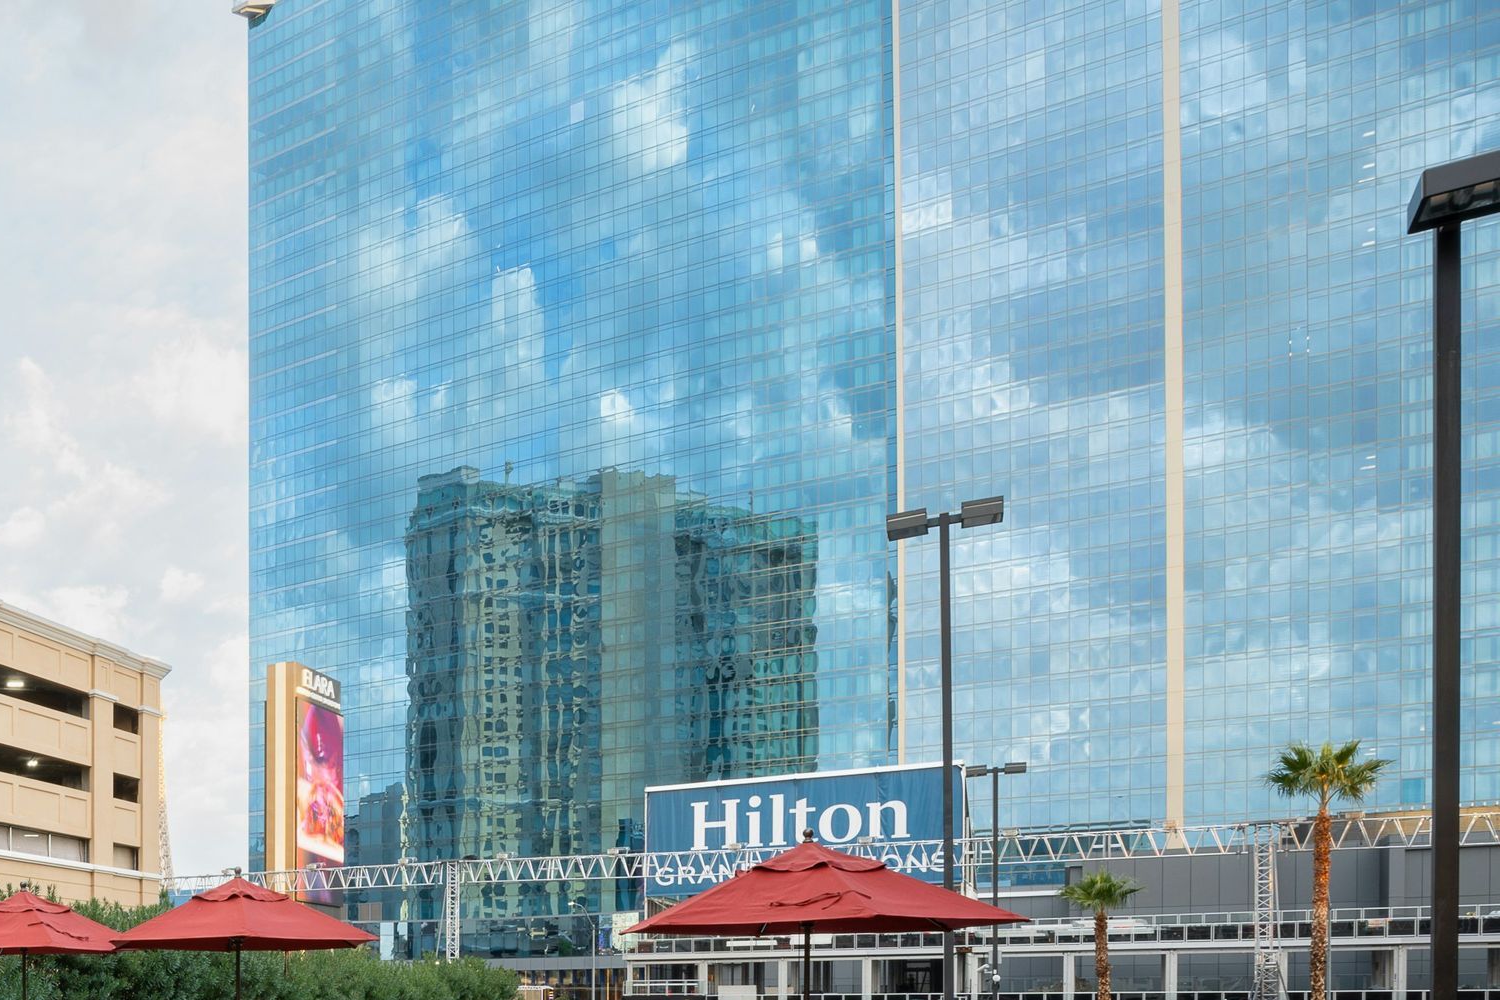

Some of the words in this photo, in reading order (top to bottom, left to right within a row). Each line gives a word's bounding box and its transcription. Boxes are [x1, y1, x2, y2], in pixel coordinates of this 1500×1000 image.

[302, 668, 335, 699] ELARA
[690, 793, 911, 851] Hilton
[655, 862, 757, 886] GRAN
